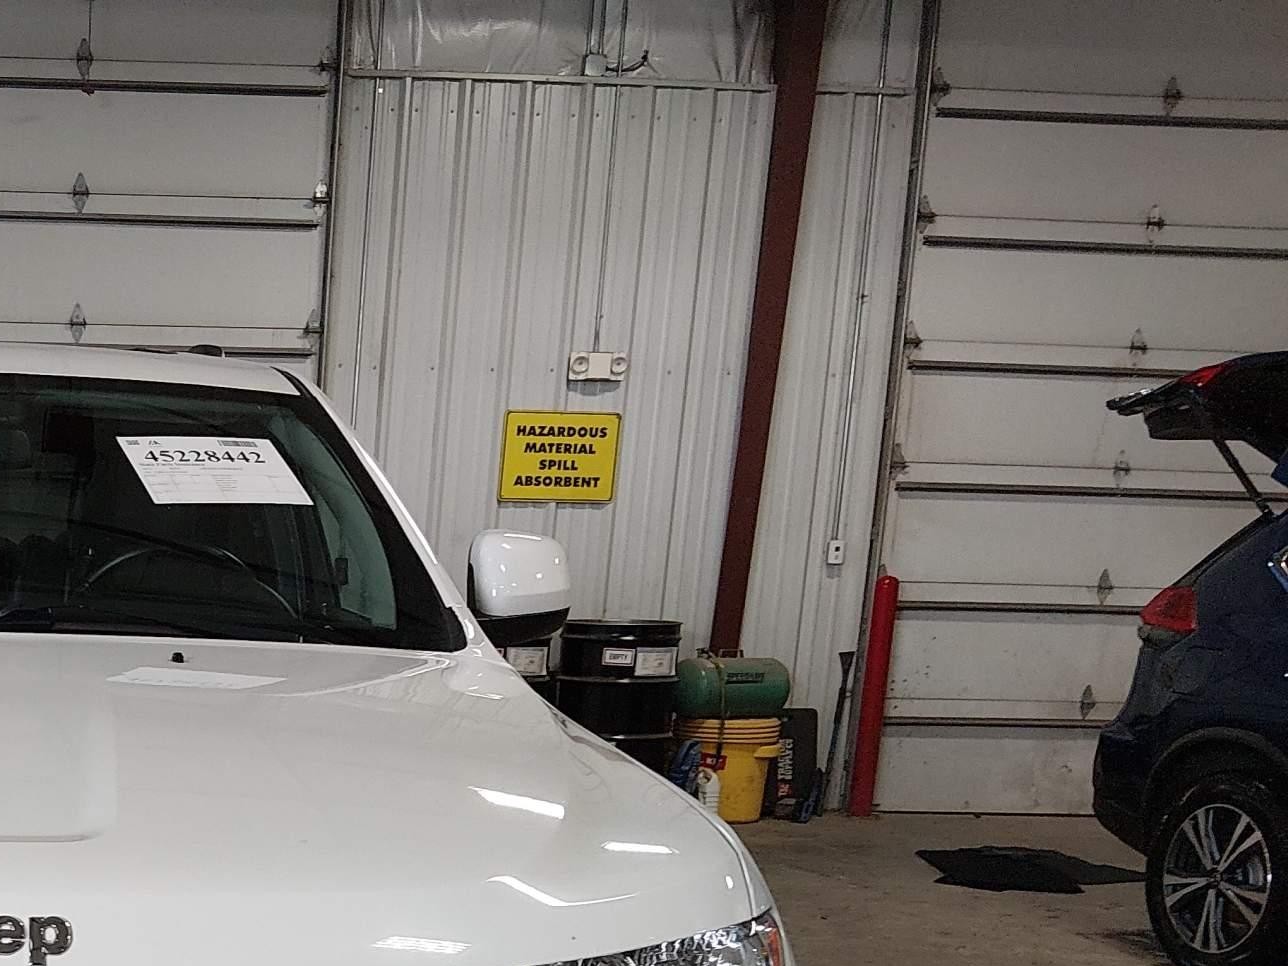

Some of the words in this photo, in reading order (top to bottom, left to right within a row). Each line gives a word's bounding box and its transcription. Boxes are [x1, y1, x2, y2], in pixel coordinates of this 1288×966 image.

[516, 425, 608, 438] HAZARDOUS
[524, 442, 596, 454] MATERIAL
[144, 450, 265, 463] 45228442
[539, 459, 578, 471] SPILL
[513, 475, 600, 488] ABSORBENT
